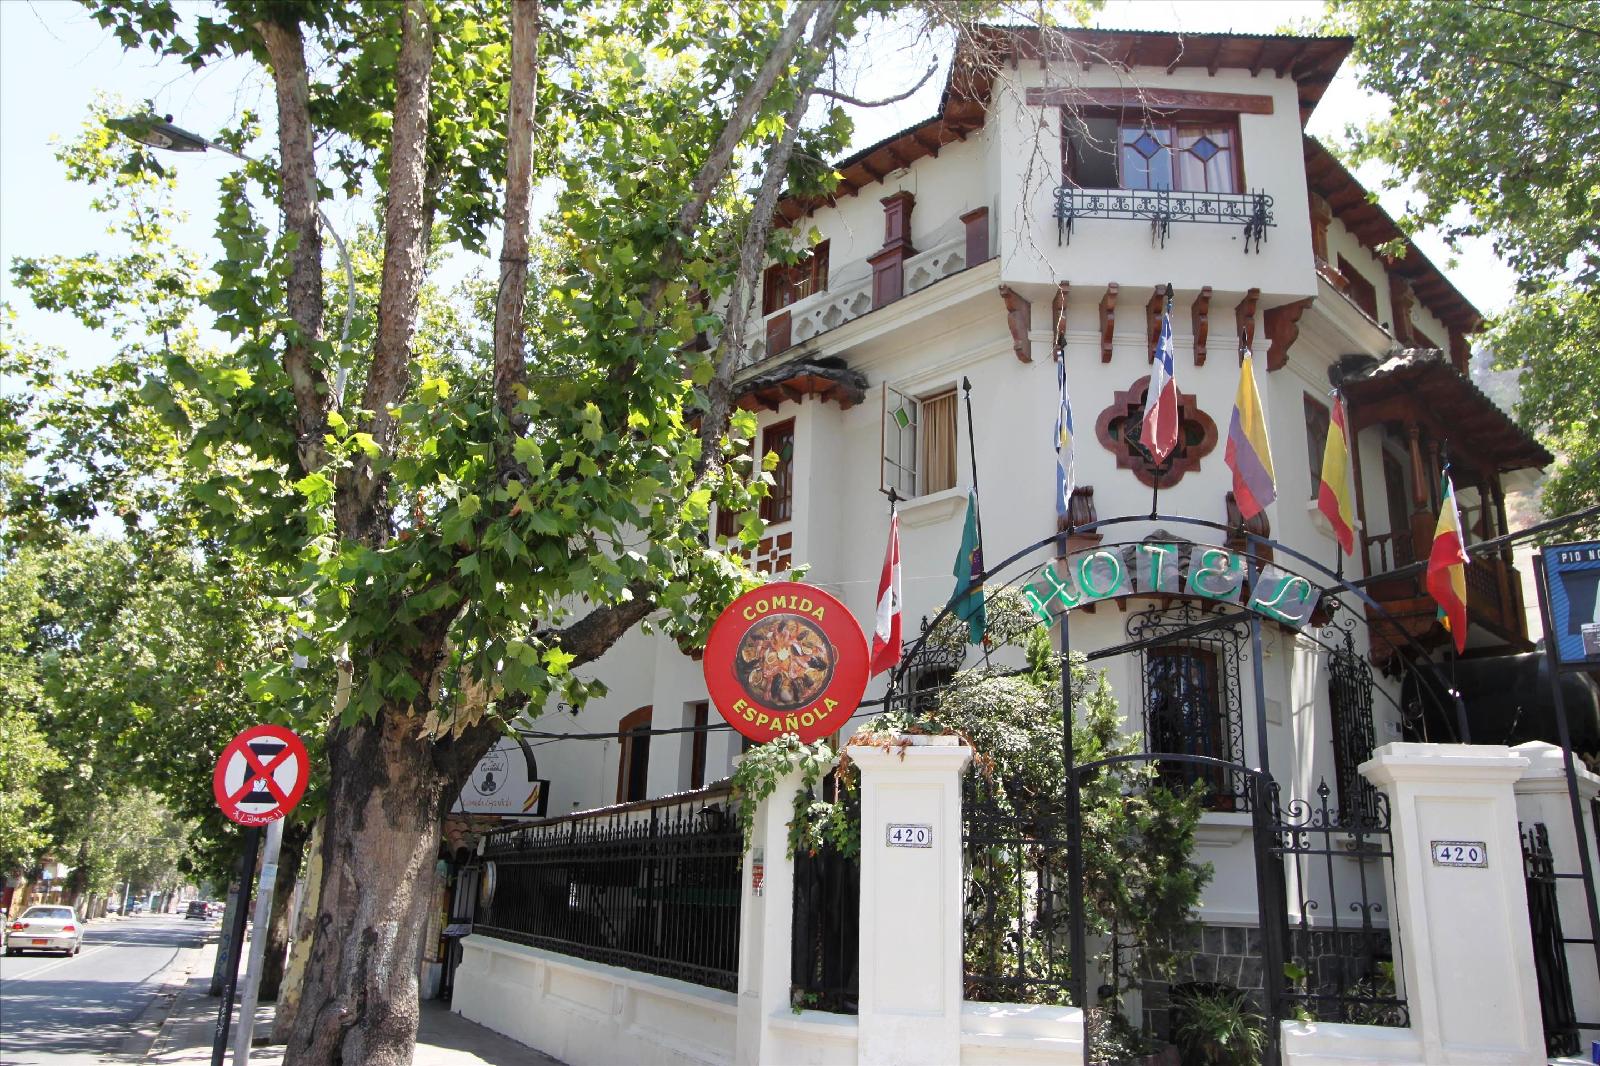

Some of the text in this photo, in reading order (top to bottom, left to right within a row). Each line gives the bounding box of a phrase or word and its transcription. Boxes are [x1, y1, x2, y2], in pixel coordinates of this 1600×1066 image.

[1561, 551, 1582, 563] PIO
[1022, 543, 1312, 628] HOTEL
[743, 595, 825, 622] COMIDA
[732, 698, 839, 732] ESPAÑOLA
[892, 829, 925, 843] 420
[1440, 846, 1478, 862] 420
